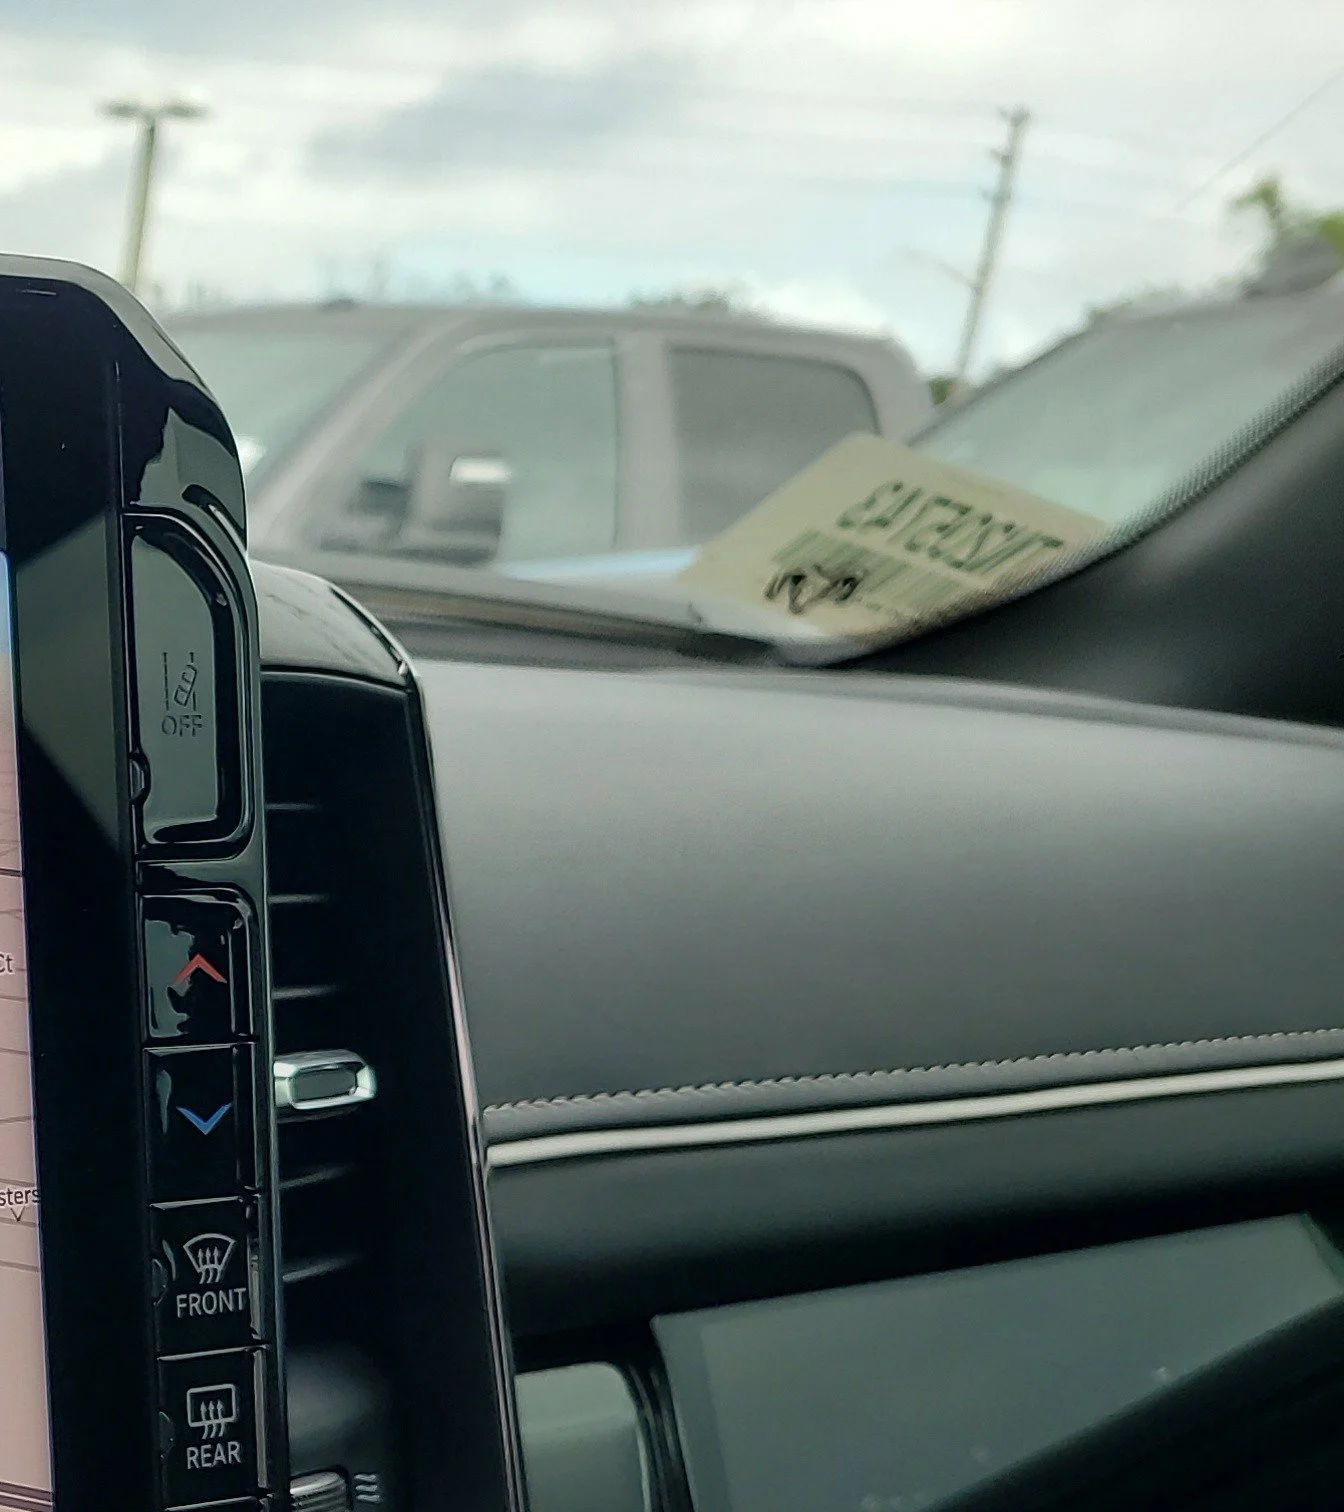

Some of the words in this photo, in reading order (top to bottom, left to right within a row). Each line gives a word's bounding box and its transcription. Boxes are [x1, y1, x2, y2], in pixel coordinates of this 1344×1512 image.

[161, 714, 203, 738] OFF
[176, 1287, 247, 1318] FRONT
[185, 1441, 242, 1470] REAR
